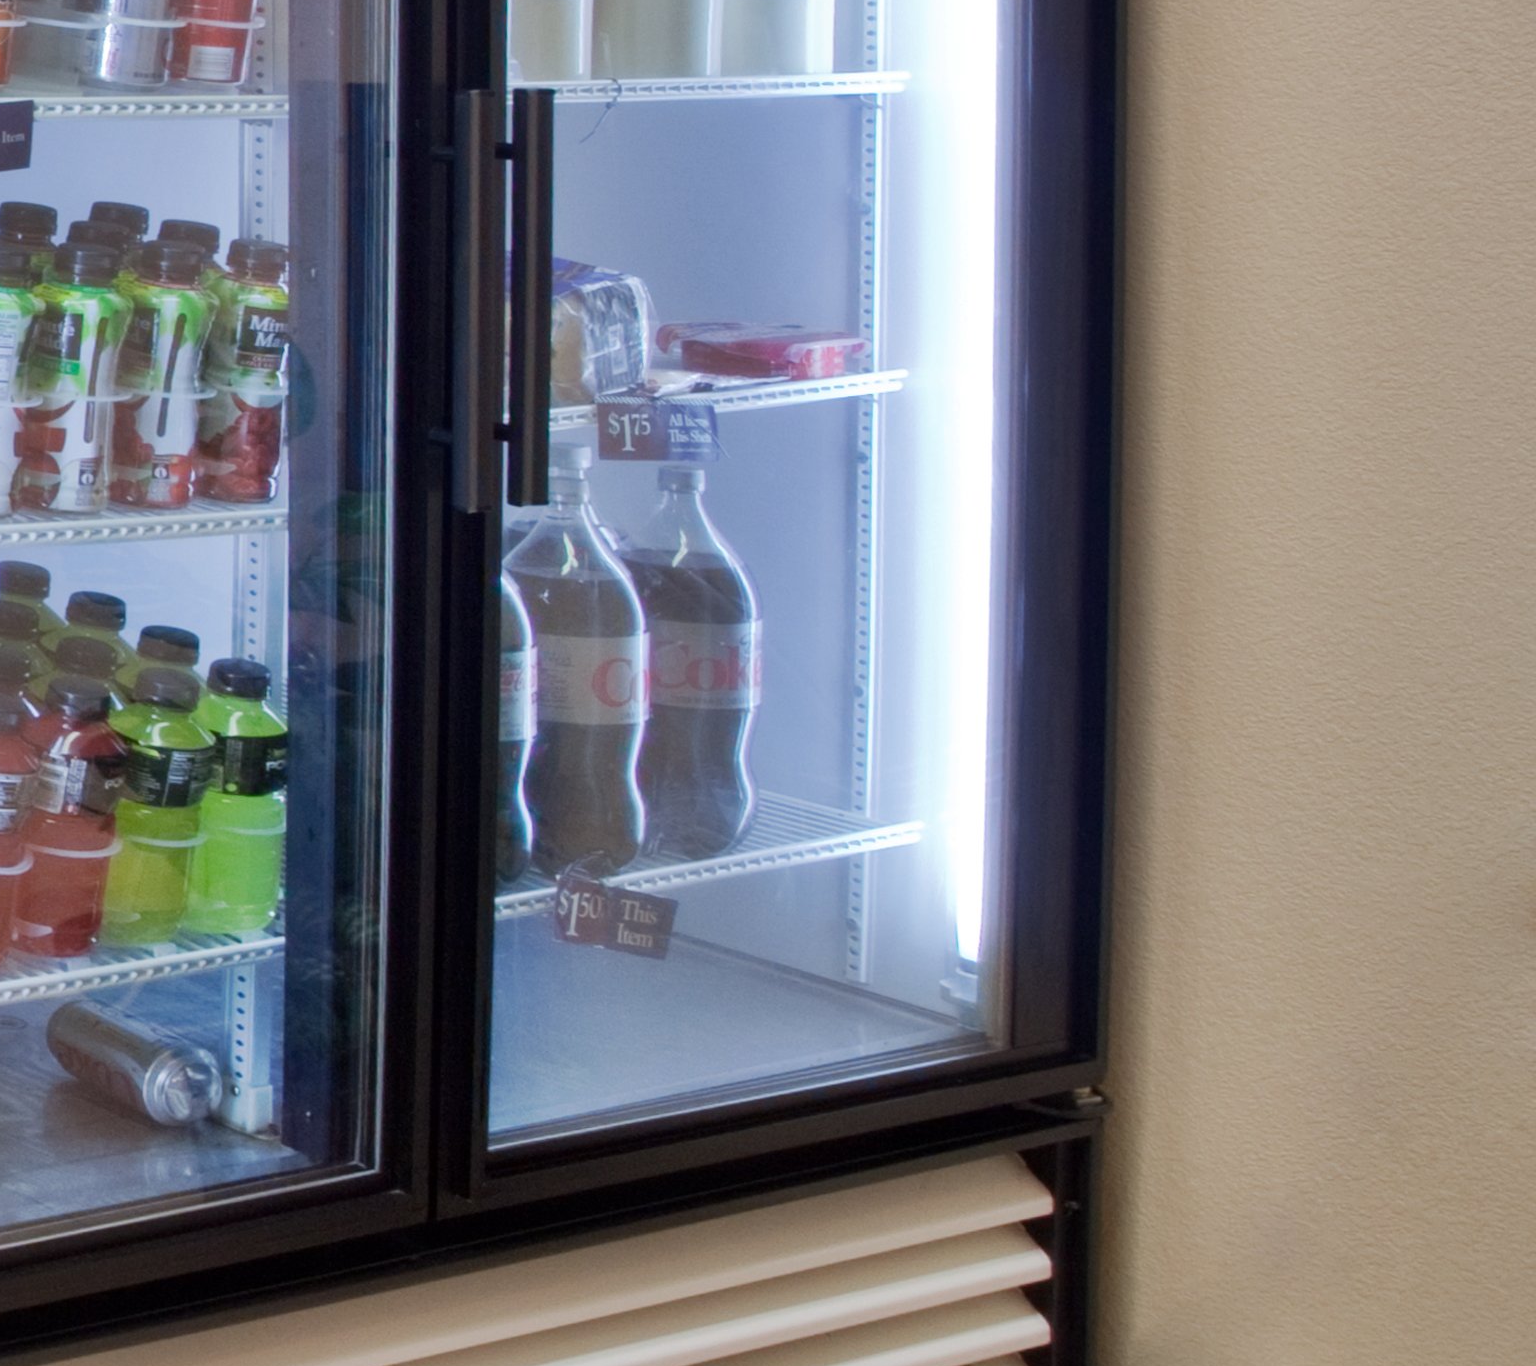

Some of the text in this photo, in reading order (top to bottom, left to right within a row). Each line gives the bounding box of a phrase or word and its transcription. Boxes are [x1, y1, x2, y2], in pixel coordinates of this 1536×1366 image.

[2, 129, 25, 144] Item
[669, 414, 683, 426] All
[669, 430, 688, 442] This
[621, 898, 657, 924] This
[617, 923, 653, 948] Item
